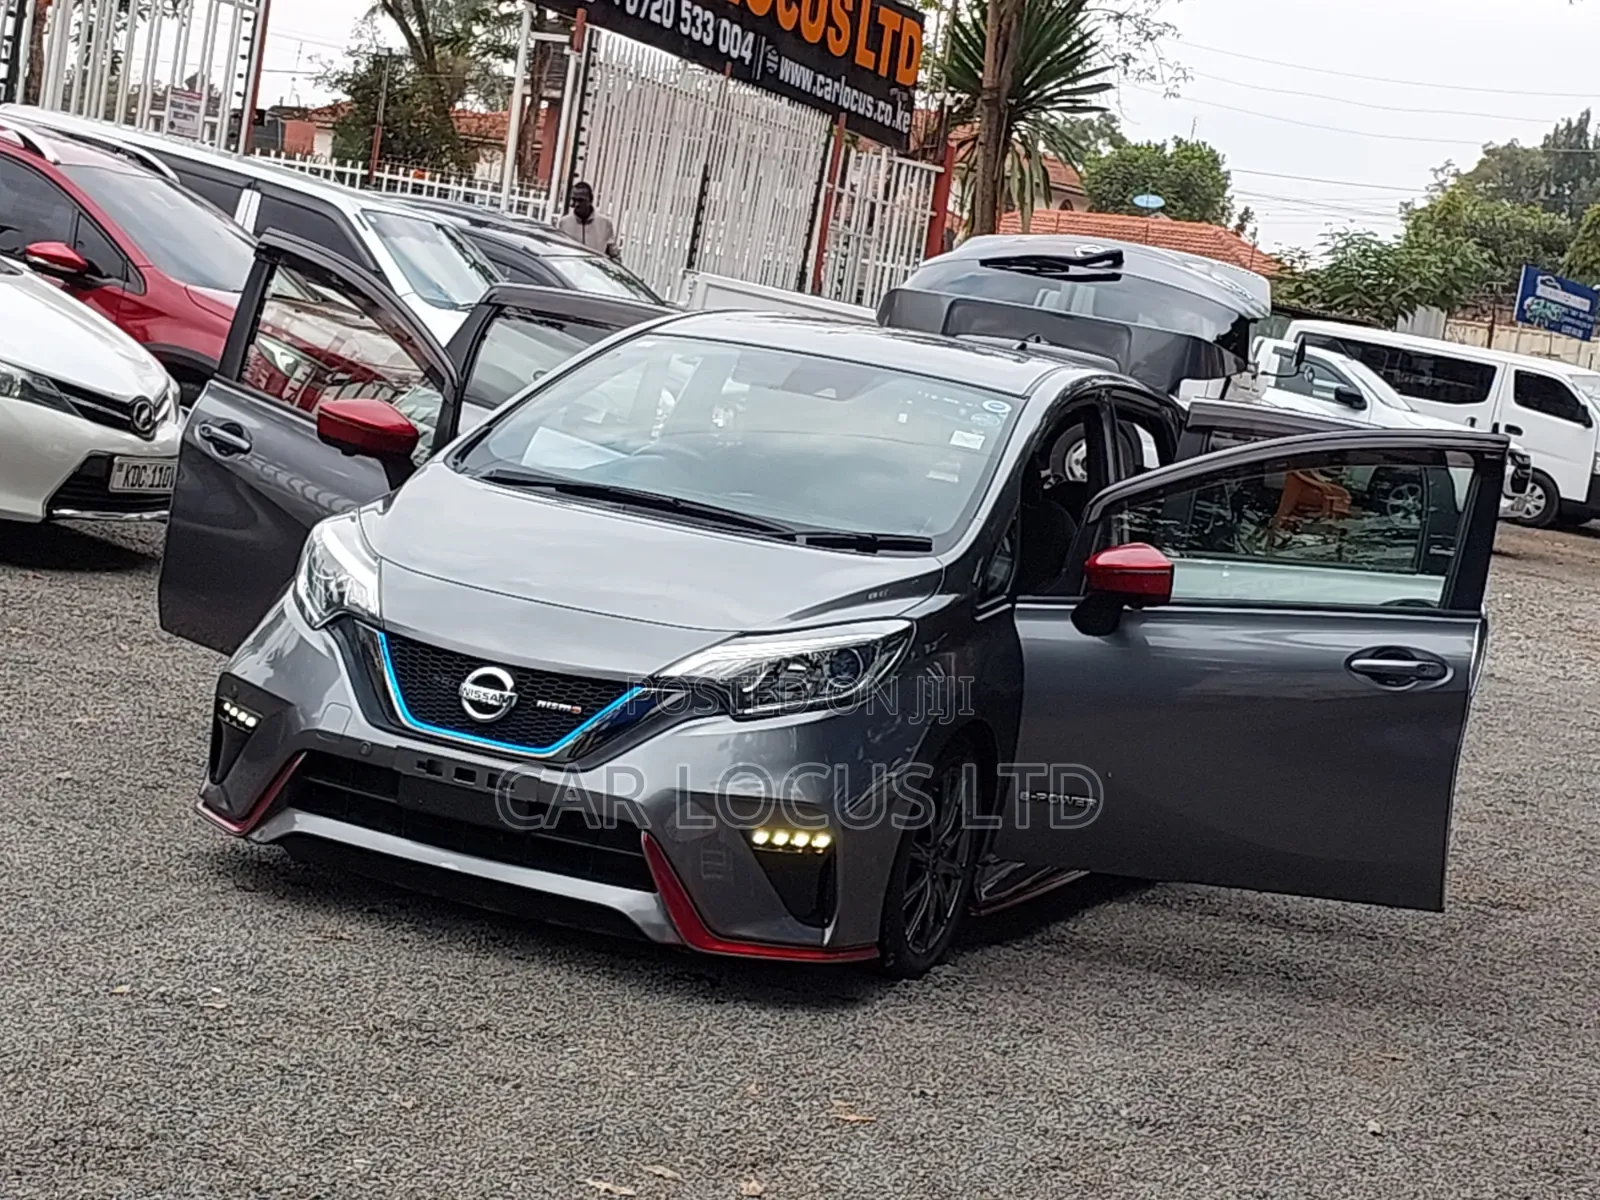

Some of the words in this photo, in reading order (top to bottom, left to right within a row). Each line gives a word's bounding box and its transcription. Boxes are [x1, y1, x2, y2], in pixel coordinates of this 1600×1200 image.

[679, 1, 714, 46] 533
[718, 18, 755, 66] 004
[778, 55, 912, 134] www.carlocus.co.ke
[854, 0, 922, 86] LTD
[122, 464, 147, 488] KDC
[462, 686, 511, 704] NISSAN
